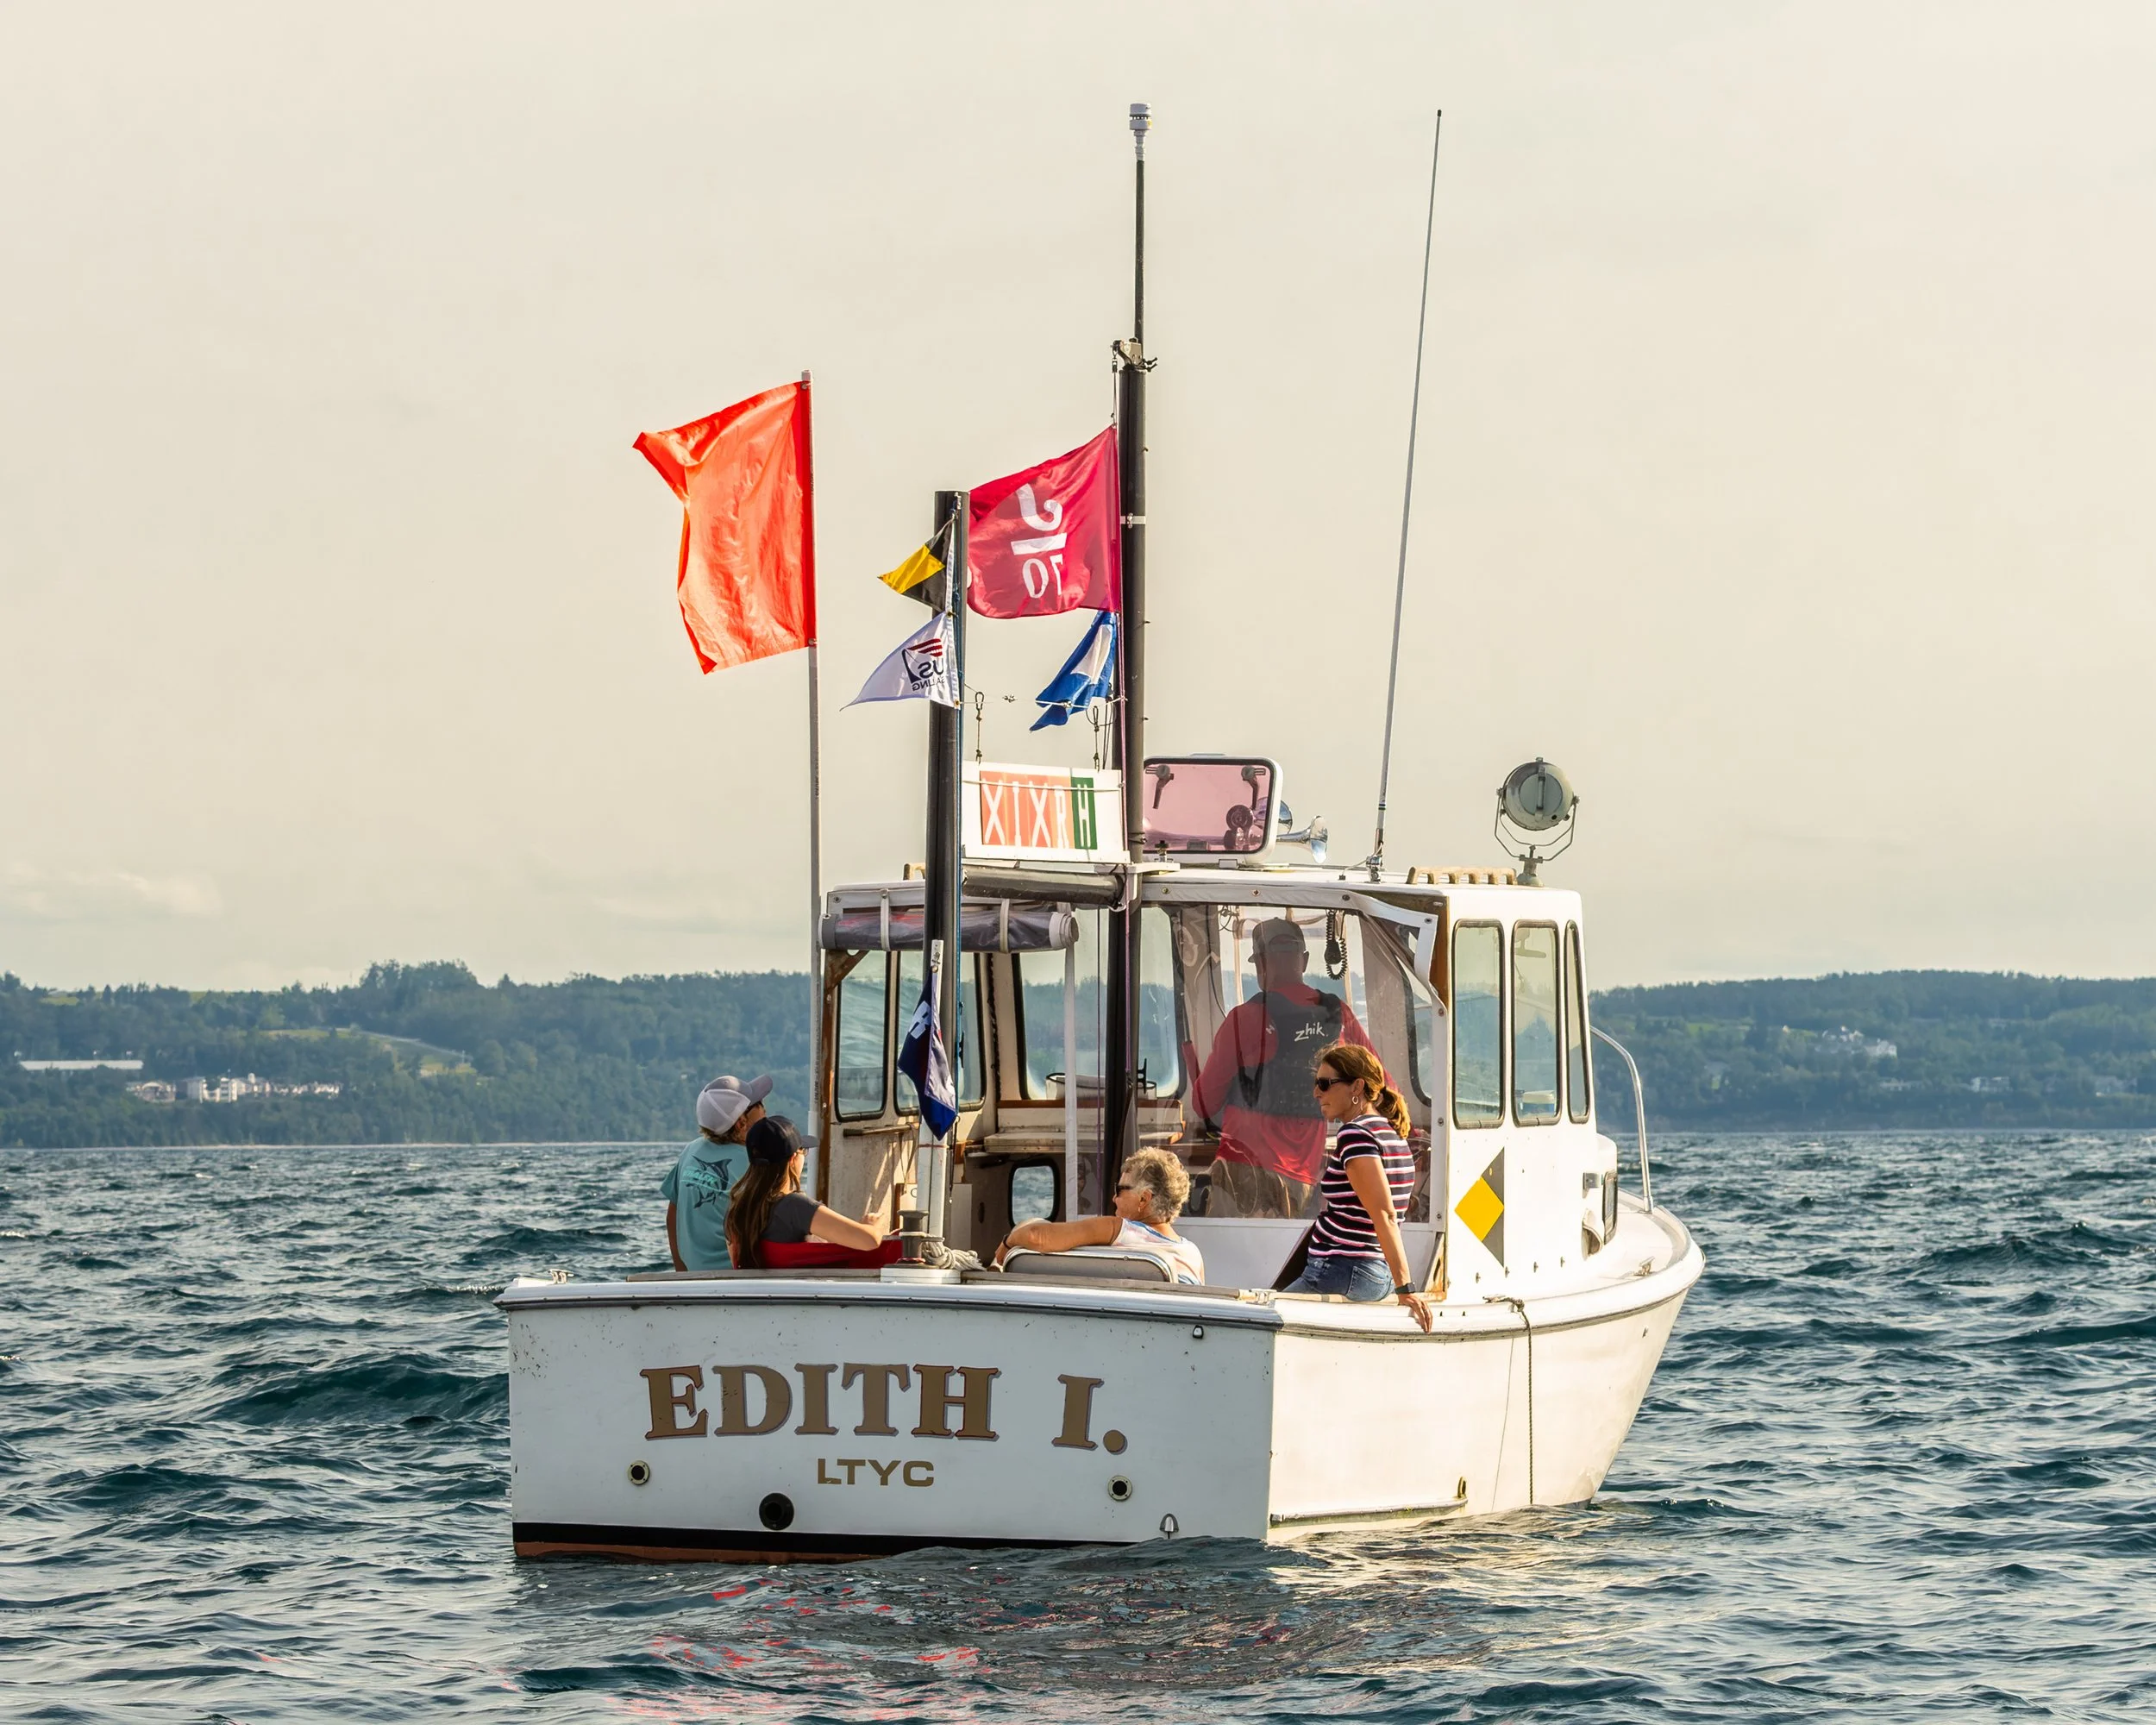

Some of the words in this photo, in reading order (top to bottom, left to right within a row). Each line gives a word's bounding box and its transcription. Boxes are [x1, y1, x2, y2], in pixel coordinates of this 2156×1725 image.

[1294, 1022, 1326, 1042] zhik
[640, 1362, 1002, 1441] EDITH
[1051, 1373, 1128, 1456] I.
[818, 1458, 935, 1487] LTYC
